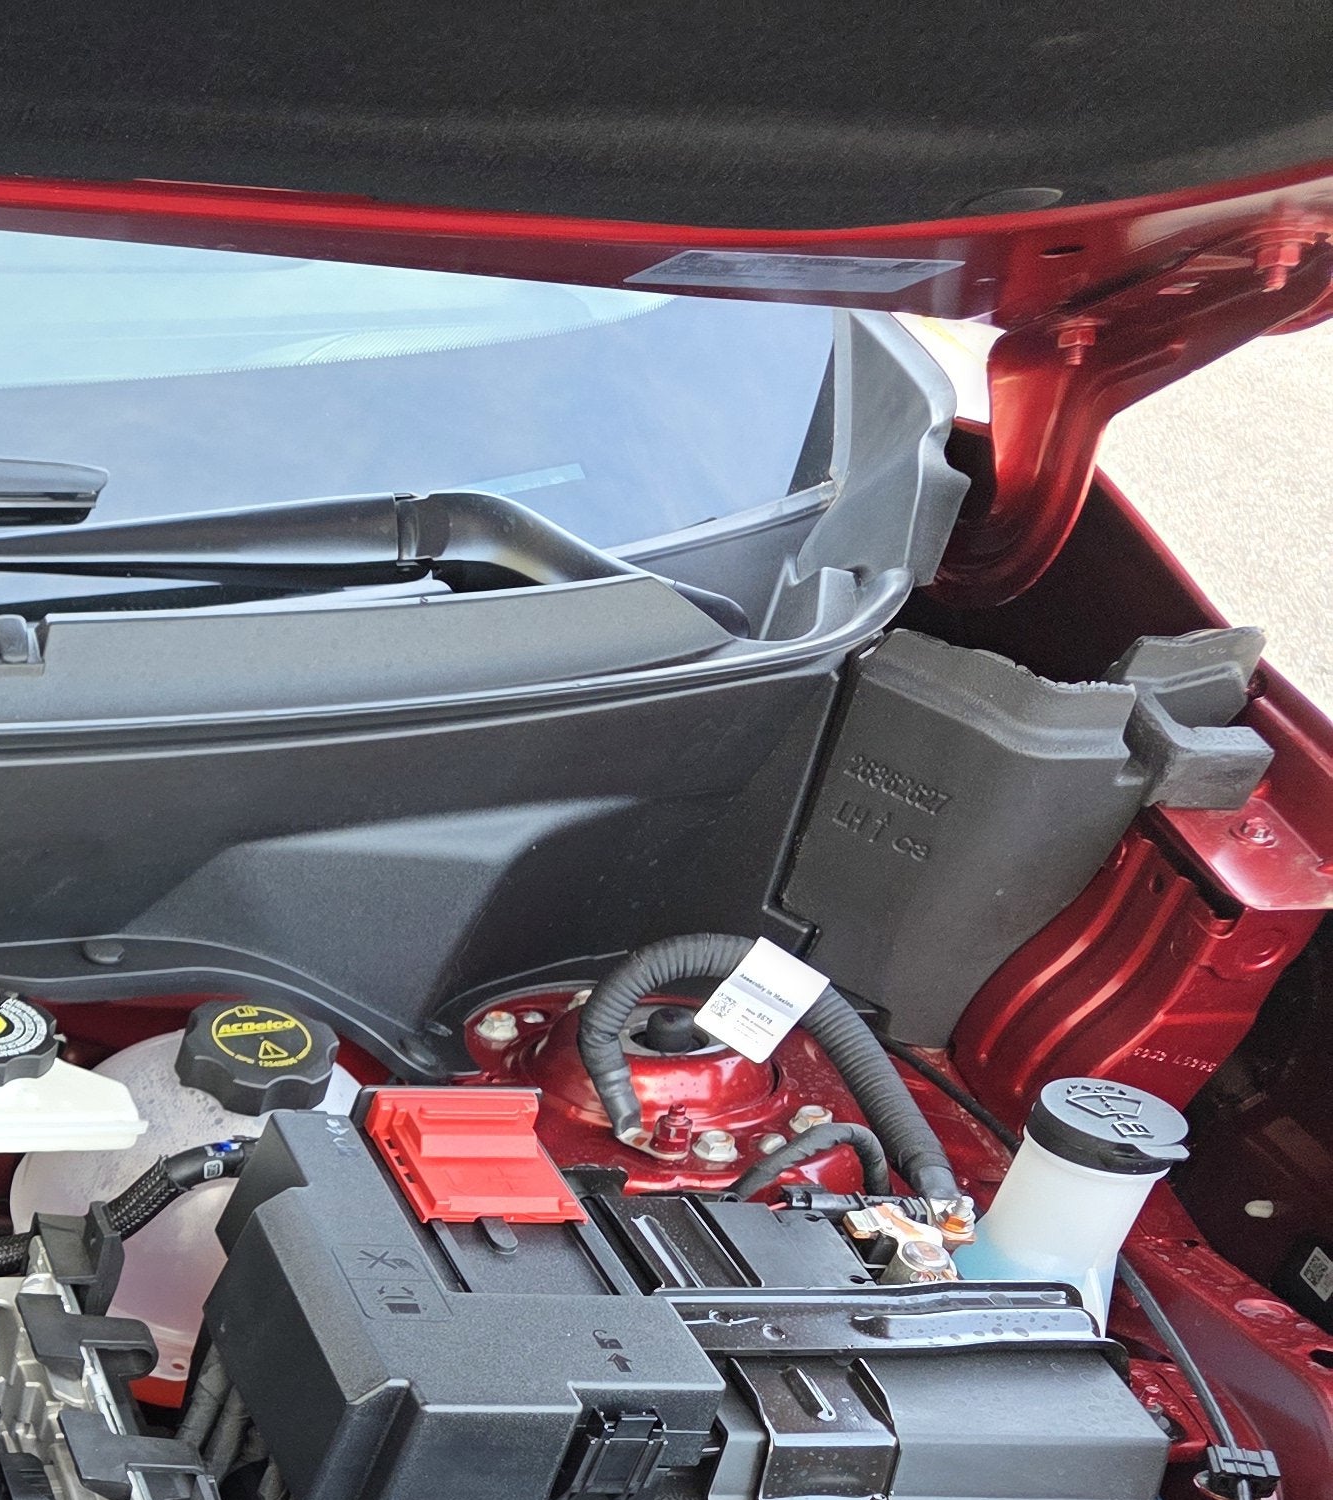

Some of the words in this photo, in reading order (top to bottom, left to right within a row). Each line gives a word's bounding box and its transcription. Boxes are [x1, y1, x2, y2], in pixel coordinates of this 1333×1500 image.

[739, 973, 766, 992] Assembly
[773, 993, 794, 1009] Mexico
[218, 1020, 297, 1034] ACDelco
